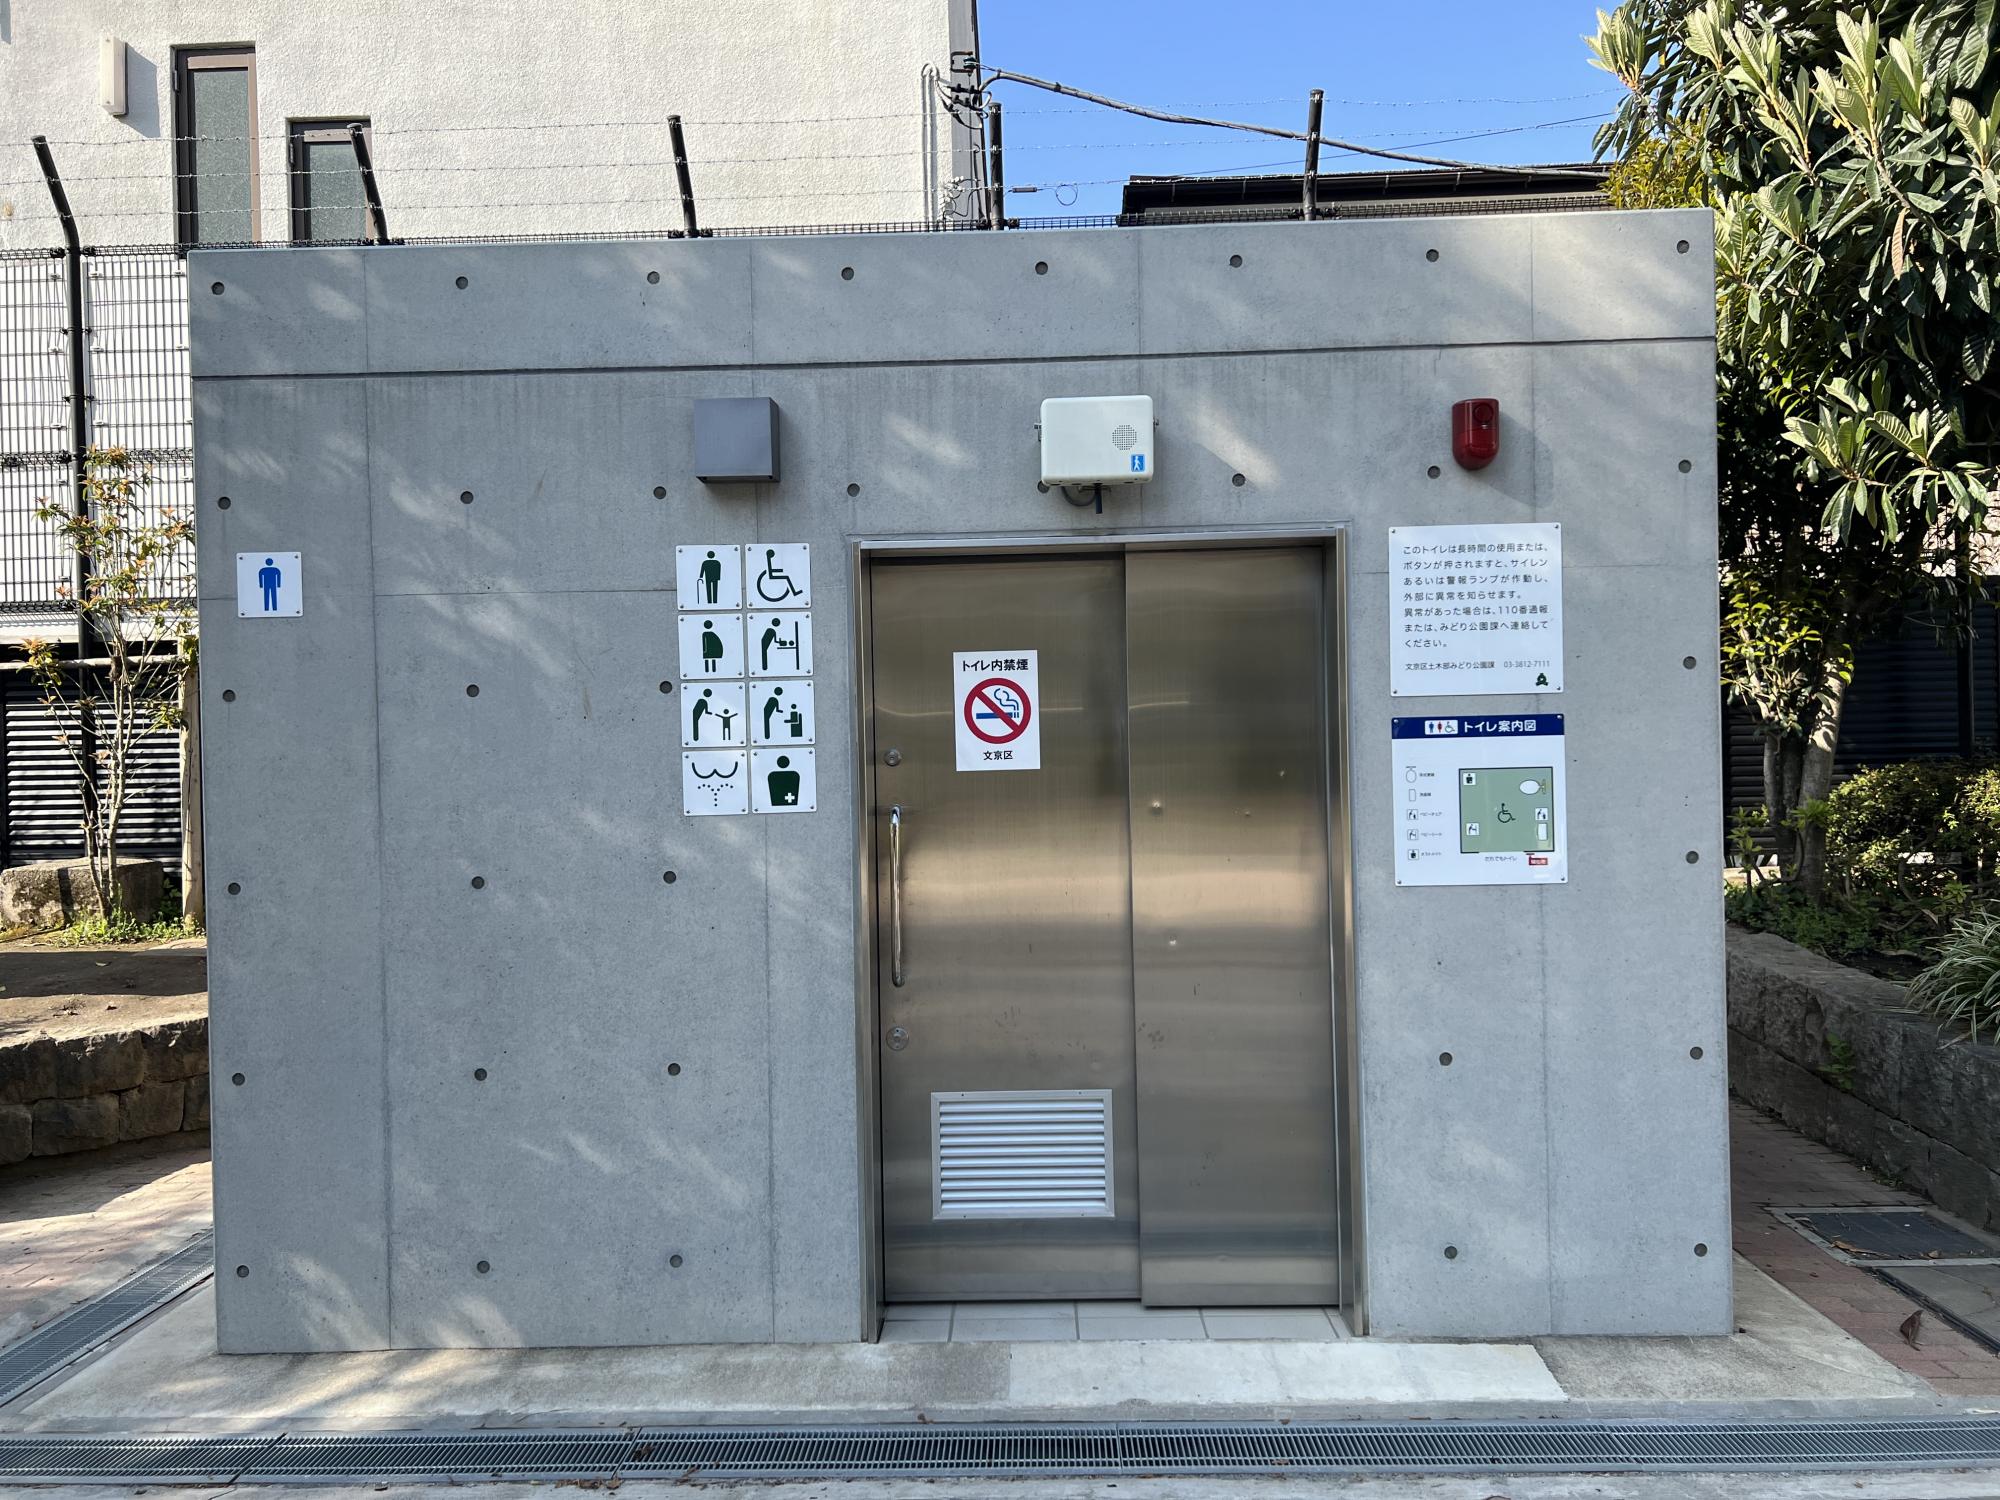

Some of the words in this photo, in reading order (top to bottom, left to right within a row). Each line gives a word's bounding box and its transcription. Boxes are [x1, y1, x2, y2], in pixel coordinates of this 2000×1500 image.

[1403, 543, 1548, 554] このトイレは長時間の使用または、
[1403, 559, 1548, 570] ボタンが押されますと、サイレン
[1403, 574, 1548, 585] あるいは警報ランプが作動し、
[1403, 590, 1521, 601] 外部に異常を知らせます。
[1404, 620, 1549, 632] または、みどり公園課へ連絡して
[1405, 639, 1447, 648] ください。
[962, 658, 1029, 672] トイレ内禁煙
[1464, 719, 1537, 733] トイレ案内図
[983, 750, 1014, 760] 文京区
